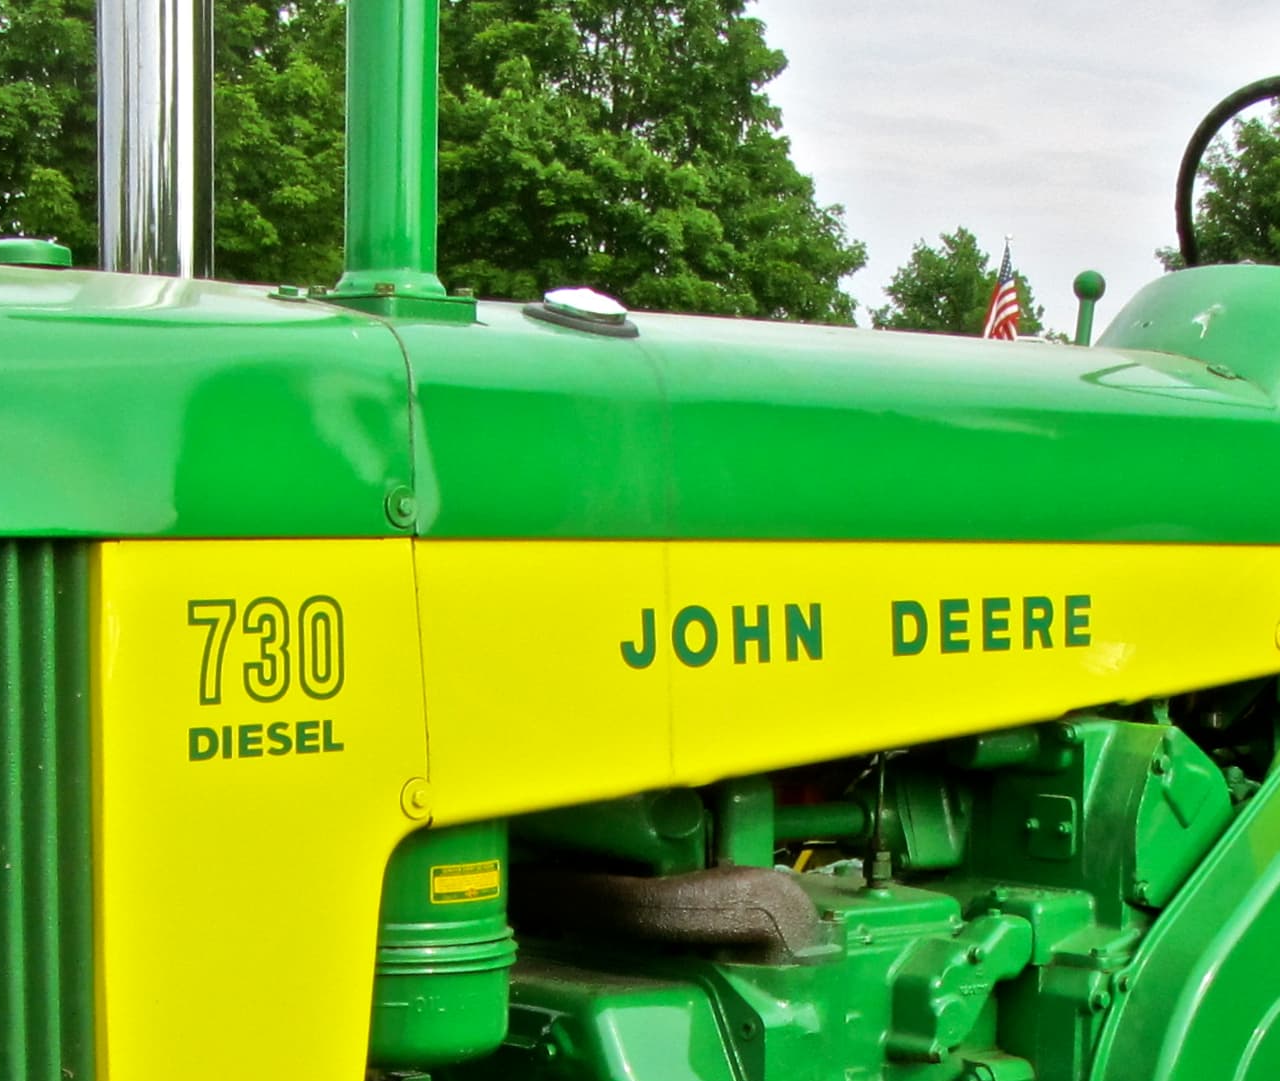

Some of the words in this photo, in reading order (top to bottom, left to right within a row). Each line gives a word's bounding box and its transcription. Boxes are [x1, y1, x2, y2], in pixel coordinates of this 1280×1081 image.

[187, 594, 345, 706] 730
[620, 602, 822, 669] JOHN
[891, 594, 1092, 656] DEERE
[188, 719, 345, 762] DIESEL
